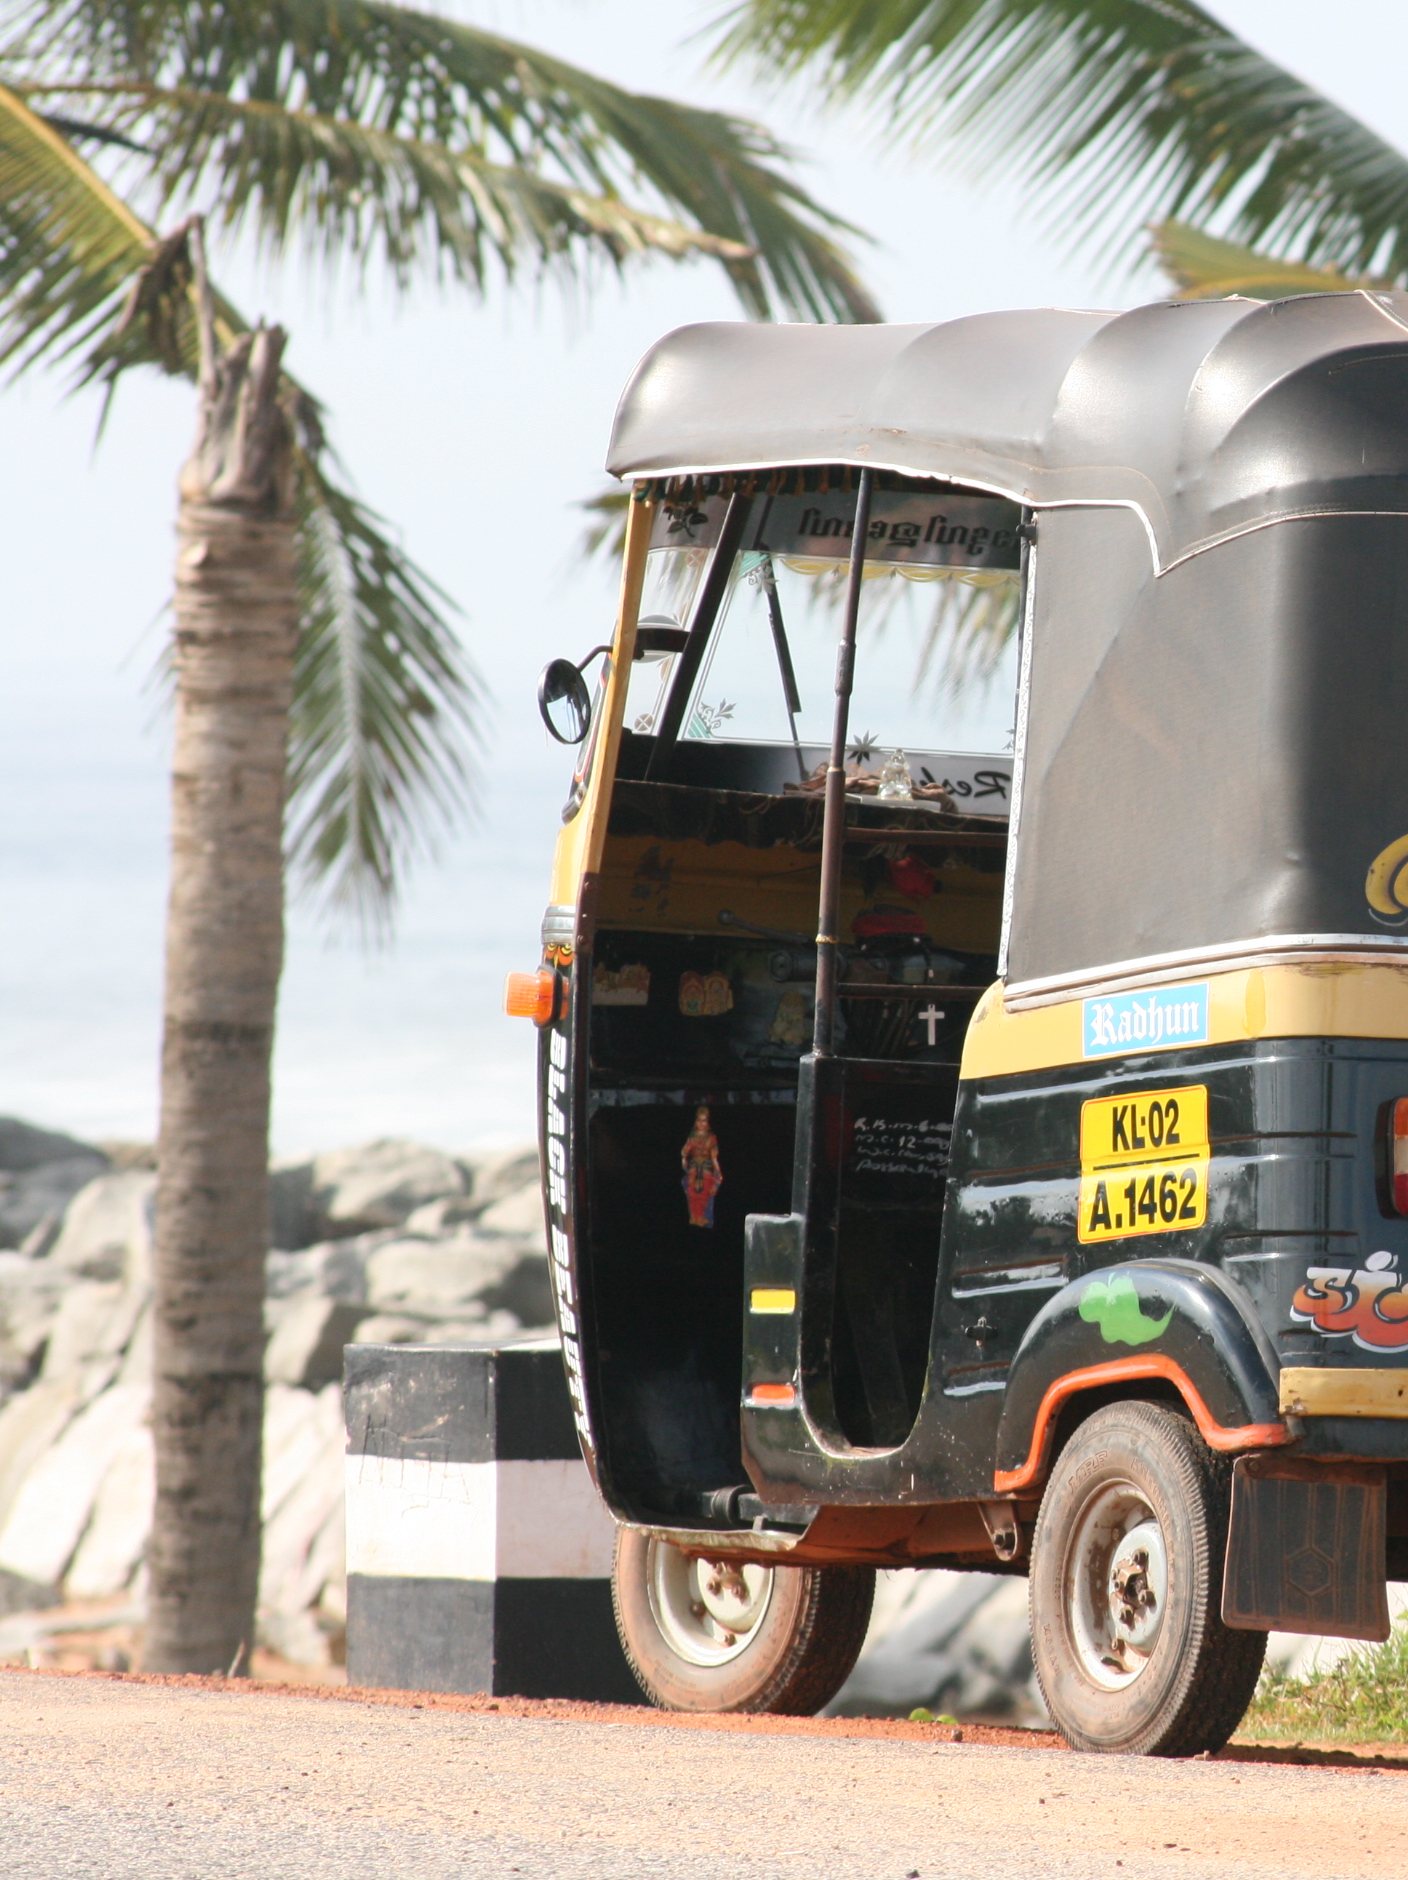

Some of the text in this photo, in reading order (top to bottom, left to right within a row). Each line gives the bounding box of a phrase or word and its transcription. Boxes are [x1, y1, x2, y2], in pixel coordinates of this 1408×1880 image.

[1089, 995, 1200, 1047] Radhun
[1088, 1167, 1198, 1233] A.1462
[547, 1027, 594, 1448] BLACK BEAUTY
